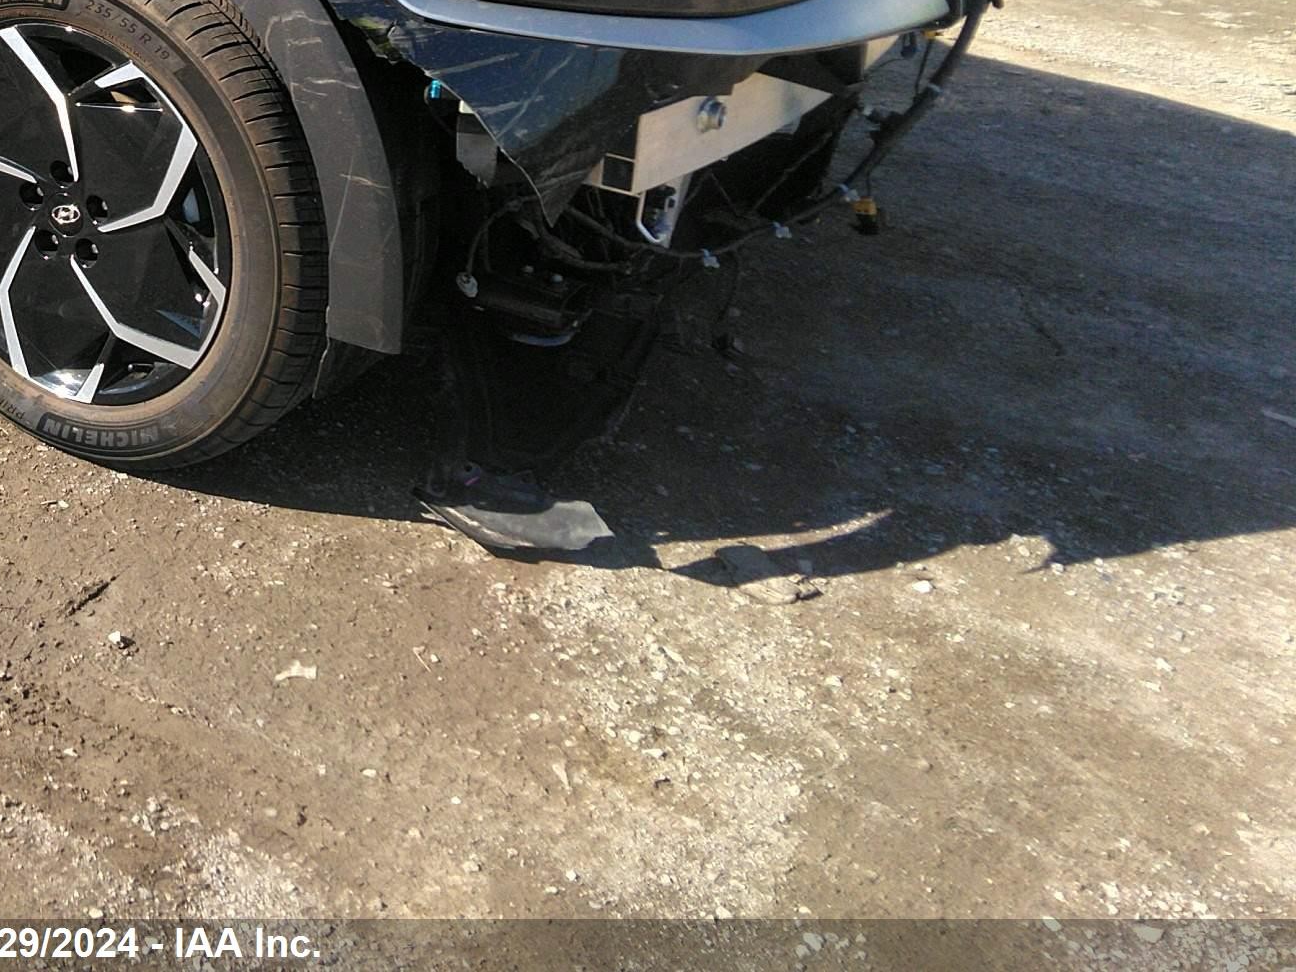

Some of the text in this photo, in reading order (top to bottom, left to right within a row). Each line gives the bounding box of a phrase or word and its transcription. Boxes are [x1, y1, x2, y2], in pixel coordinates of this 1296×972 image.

[86, 0, 138, 34] 235/55
[139, 32, 152, 45] R
[154, 46, 170, 60] 19
[43, 417, 160, 448] MICHELIN
